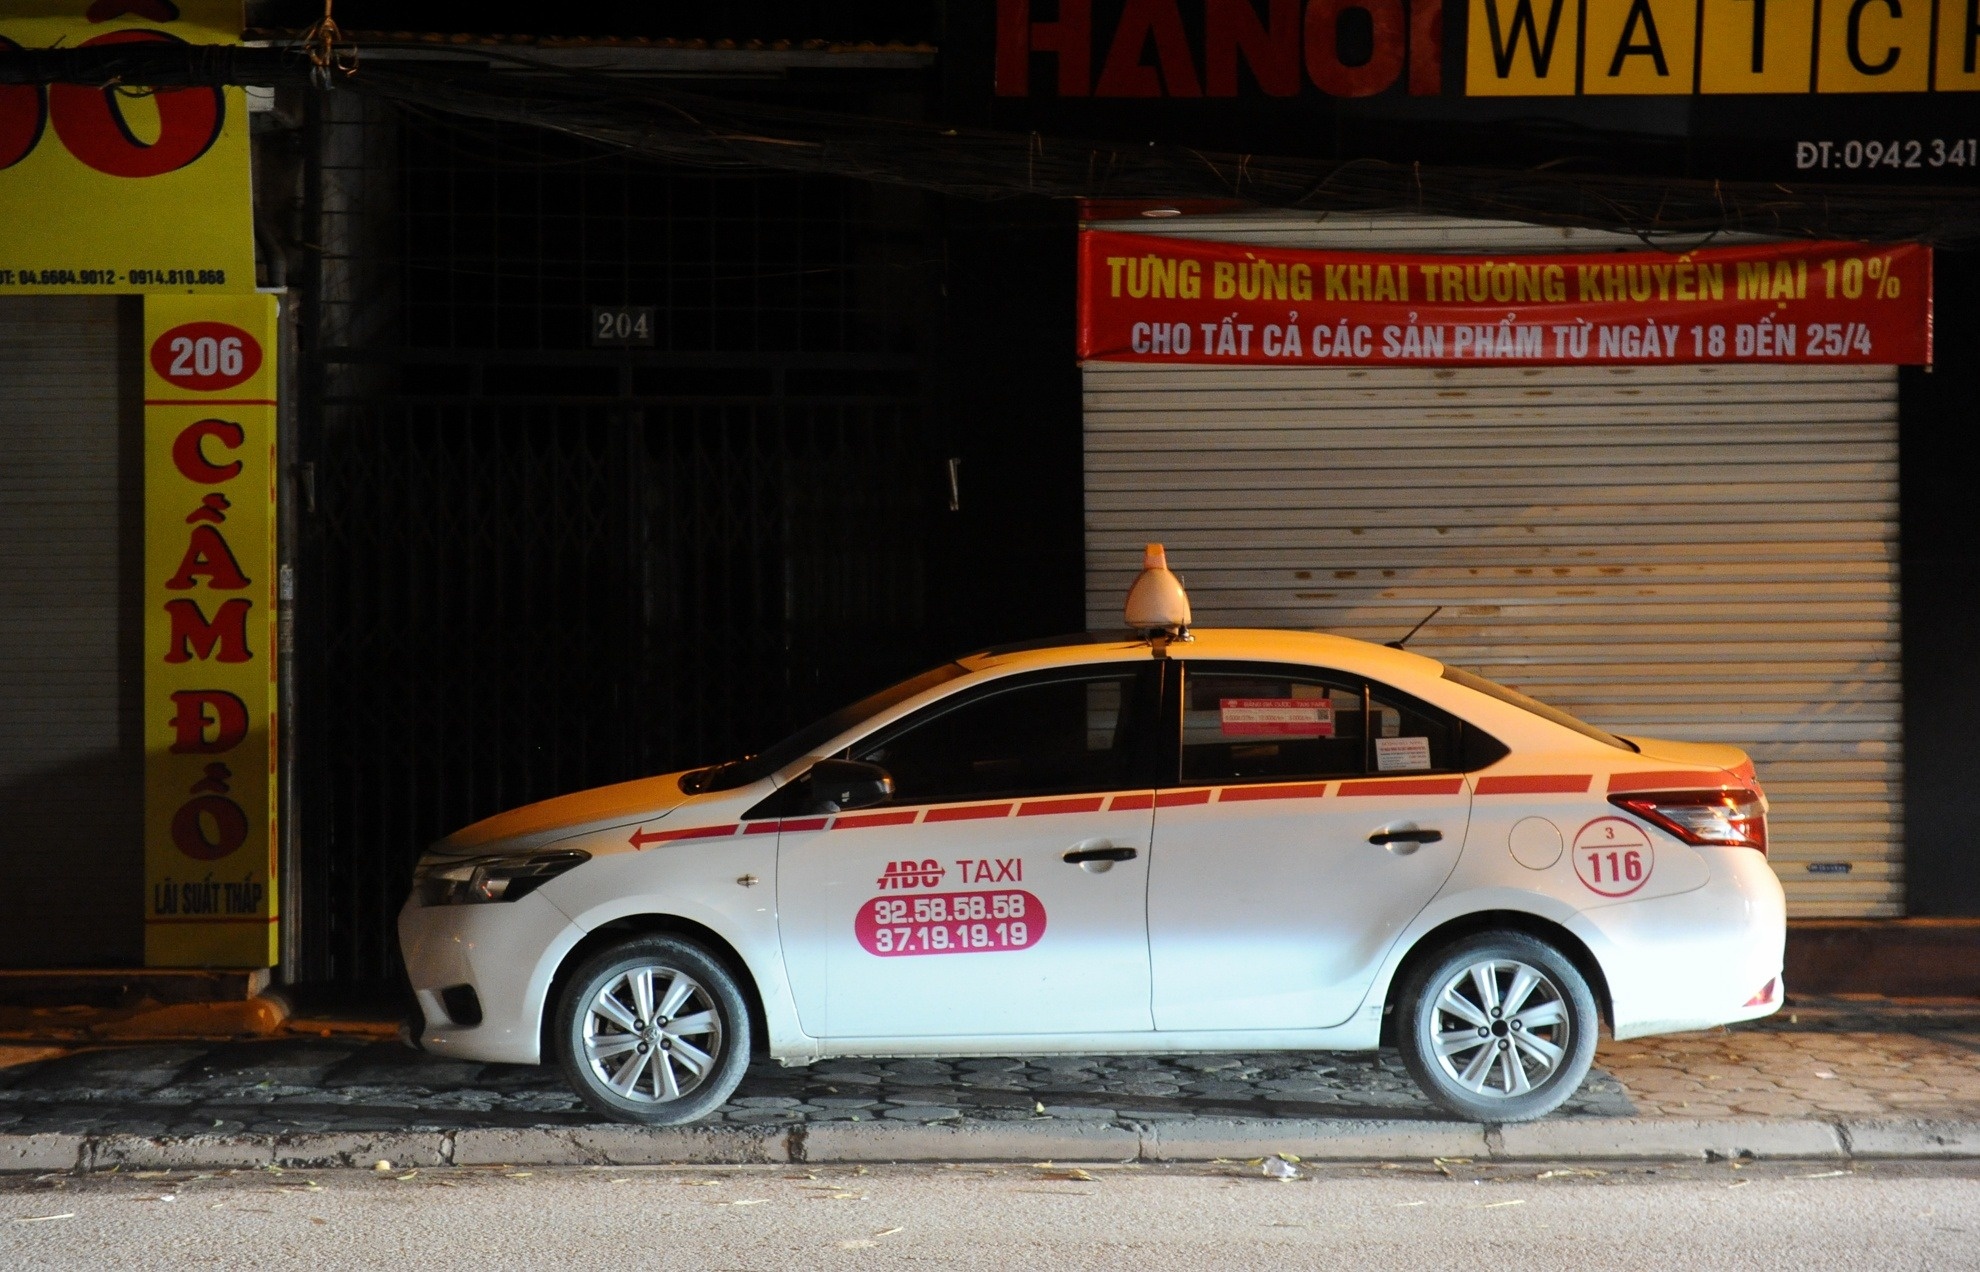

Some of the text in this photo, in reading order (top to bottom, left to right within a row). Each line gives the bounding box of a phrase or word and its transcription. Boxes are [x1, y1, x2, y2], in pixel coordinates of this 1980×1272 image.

[995, 0, 1443, 97] HANOI
[1795, 138, 1978, 170] ĐT:0942 341
[1213, 252, 1313, 301] BỪNG
[1325, 263, 1410, 302] KHAI
[1420, 261, 1567, 302] TRƯƠNG
[1577, 250, 1724, 302] KHUYẾN
[1737, 259, 1808, 309] MẠI
[1822, 256, 1901, 300] 10%
[598, 312, 649, 339] 204
[1131, 310, 1873, 359] CHO TẤT CẢ CÁC SẢN PHẨM TỪ NGÀY 18 ĐẾN 25/4
[168, 336, 245, 377] 206
[1605, 826, 1615, 840] 3
[955, 858, 1023, 884] TAXI
[1587, 850, 1643, 883] 116
[874, 894, 1026, 925] 32.58.58.58
[875, 922, 1029, 952] 37.19.19.19
